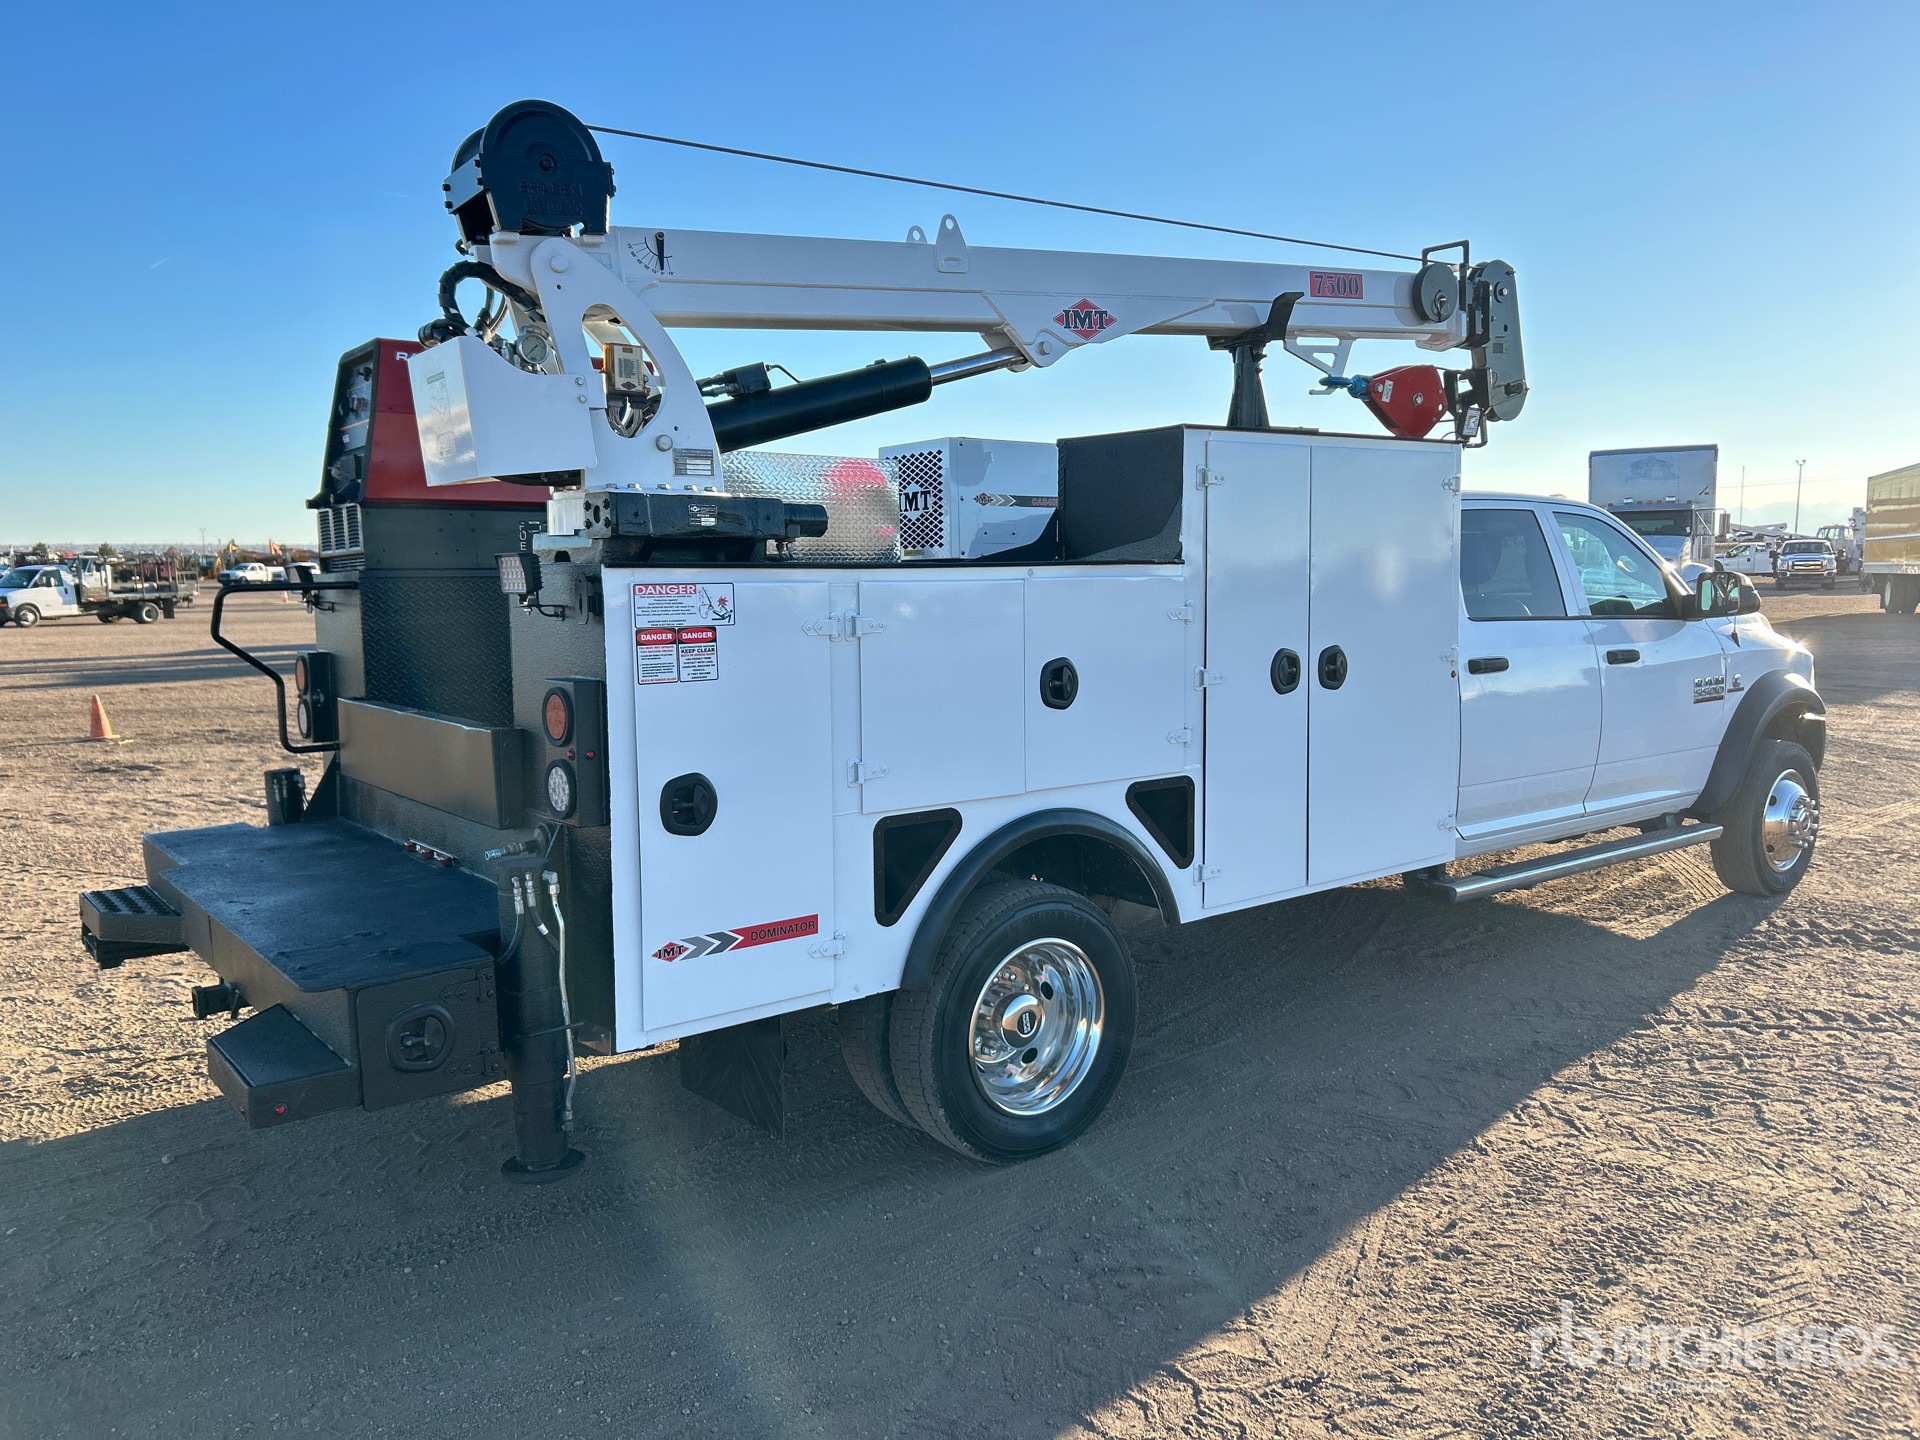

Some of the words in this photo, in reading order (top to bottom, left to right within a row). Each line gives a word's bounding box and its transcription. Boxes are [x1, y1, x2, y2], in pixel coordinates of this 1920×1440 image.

[519, 181, 584, 197] BRADEN
[1314, 274, 1359, 296] 7500
[1063, 309, 1108, 329] IMT
[635, 584, 696, 594] DANGER
[641, 633, 673, 641] DANGER
[1694, 676, 1724, 687] RAM
[1694, 685, 1724, 697] 5500
[751, 920, 815, 941] DOMINATOR
[657, 945, 684, 960] IMT
